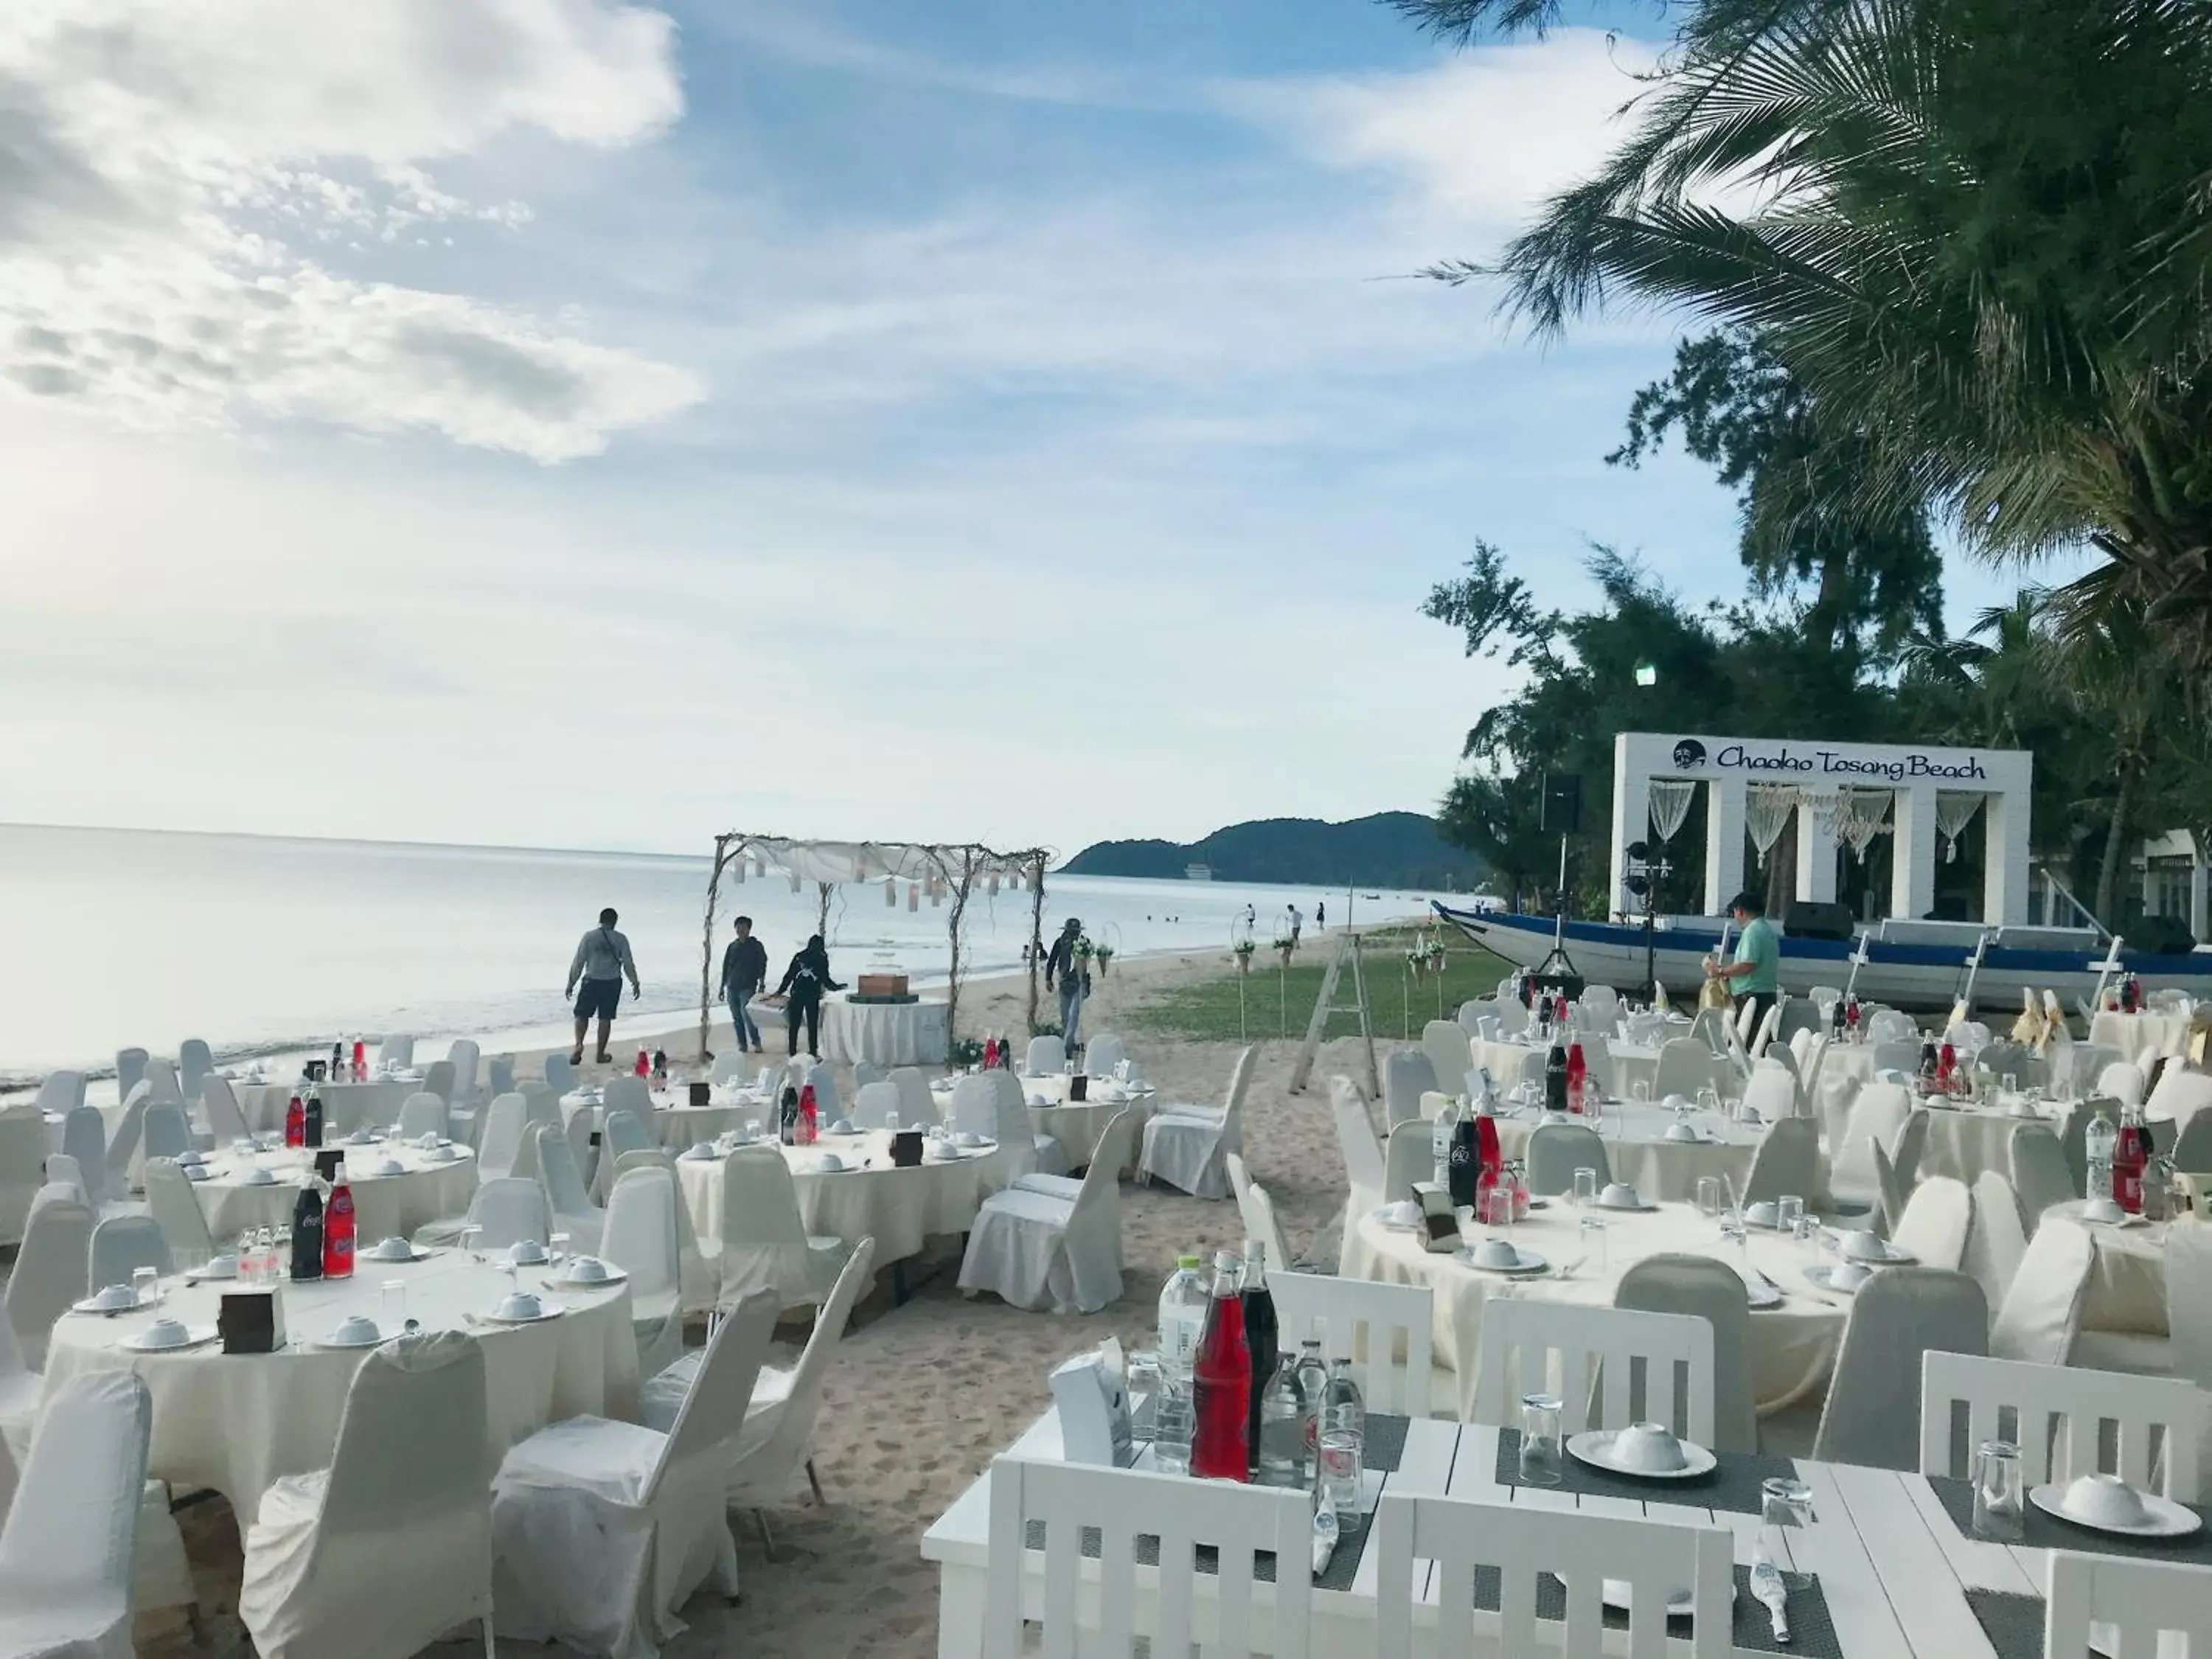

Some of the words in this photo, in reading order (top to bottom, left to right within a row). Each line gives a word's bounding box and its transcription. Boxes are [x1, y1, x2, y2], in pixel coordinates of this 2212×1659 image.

[1717, 746, 1813, 771] Chaolao
[1817, 751, 1905, 781] Tosang
[1907, 754, 1986, 780] Beach
